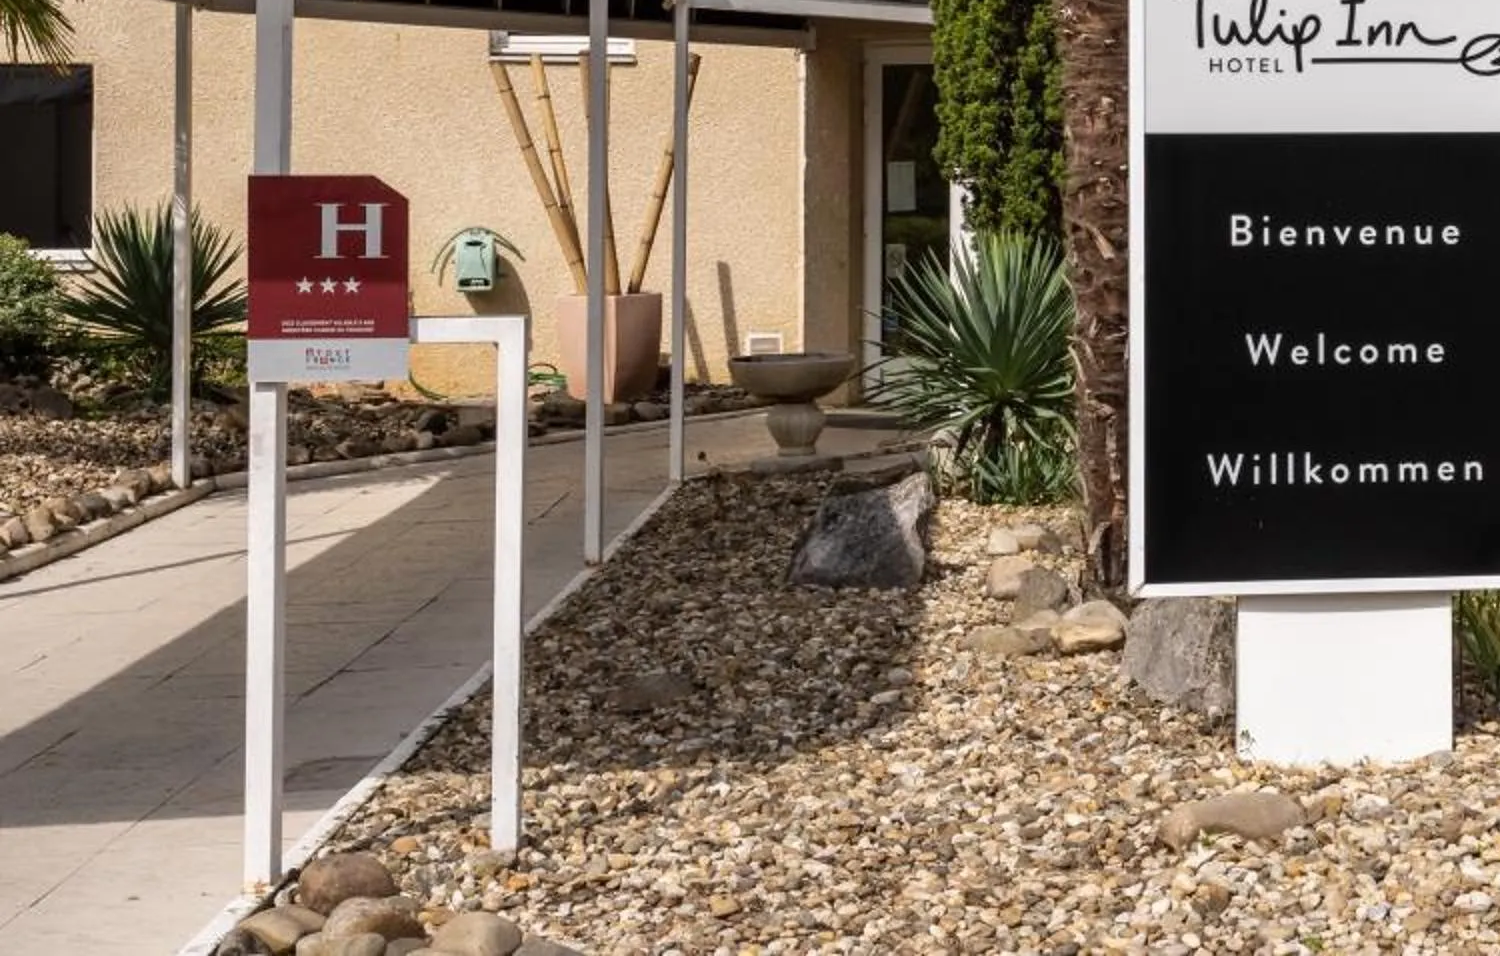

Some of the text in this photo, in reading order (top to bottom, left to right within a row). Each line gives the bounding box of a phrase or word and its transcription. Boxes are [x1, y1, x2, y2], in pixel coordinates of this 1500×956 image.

[1208, 56, 1284, 74] HOTEL
[312, 201, 392, 260] H
[1230, 213, 1461, 247] Bienvenue
[1244, 331, 1446, 366] Welcome
[1206, 450, 1484, 486] Willkommen
